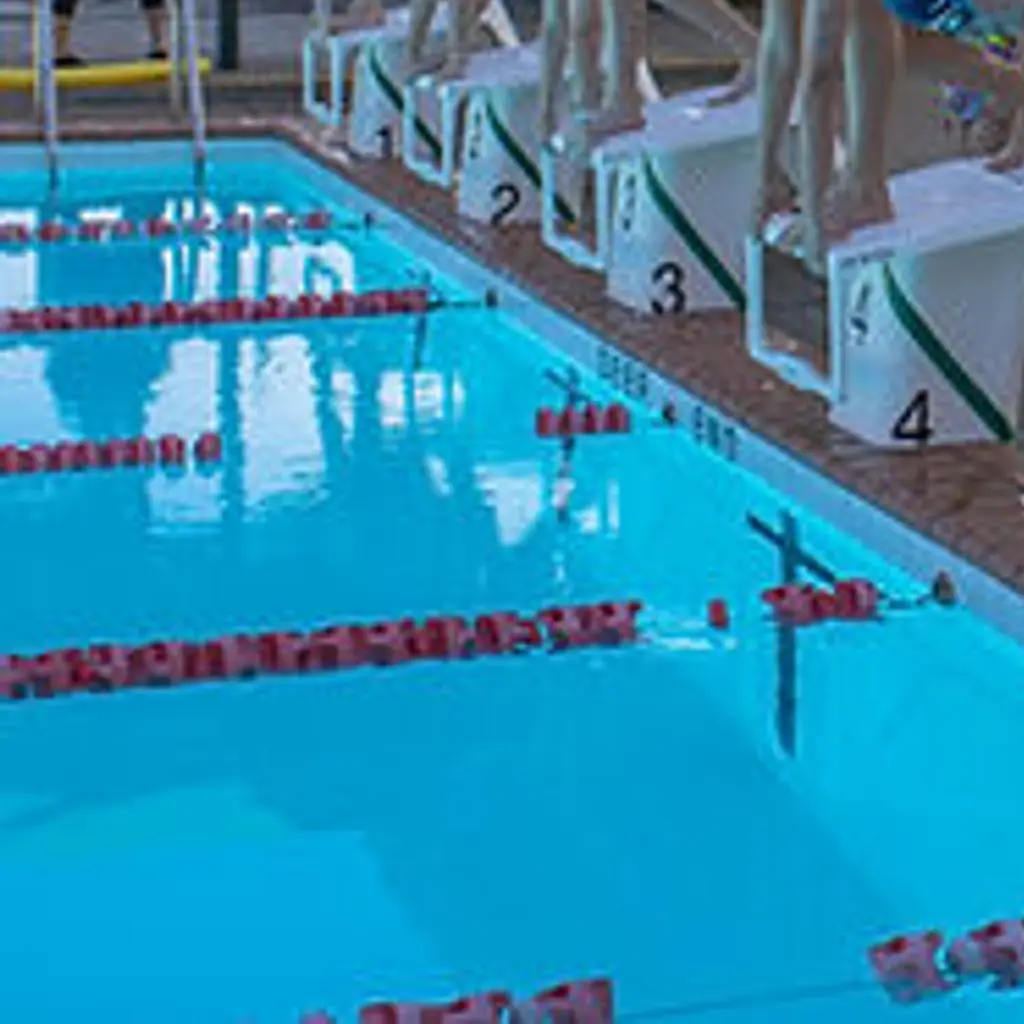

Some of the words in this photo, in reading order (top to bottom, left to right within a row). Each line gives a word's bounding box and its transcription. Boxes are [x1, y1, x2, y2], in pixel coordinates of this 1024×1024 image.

[375, 125, 393, 157] 1
[490, 182, 520, 226] 2
[651, 261, 686, 315] 3
[891, 389, 934, 444] 4
